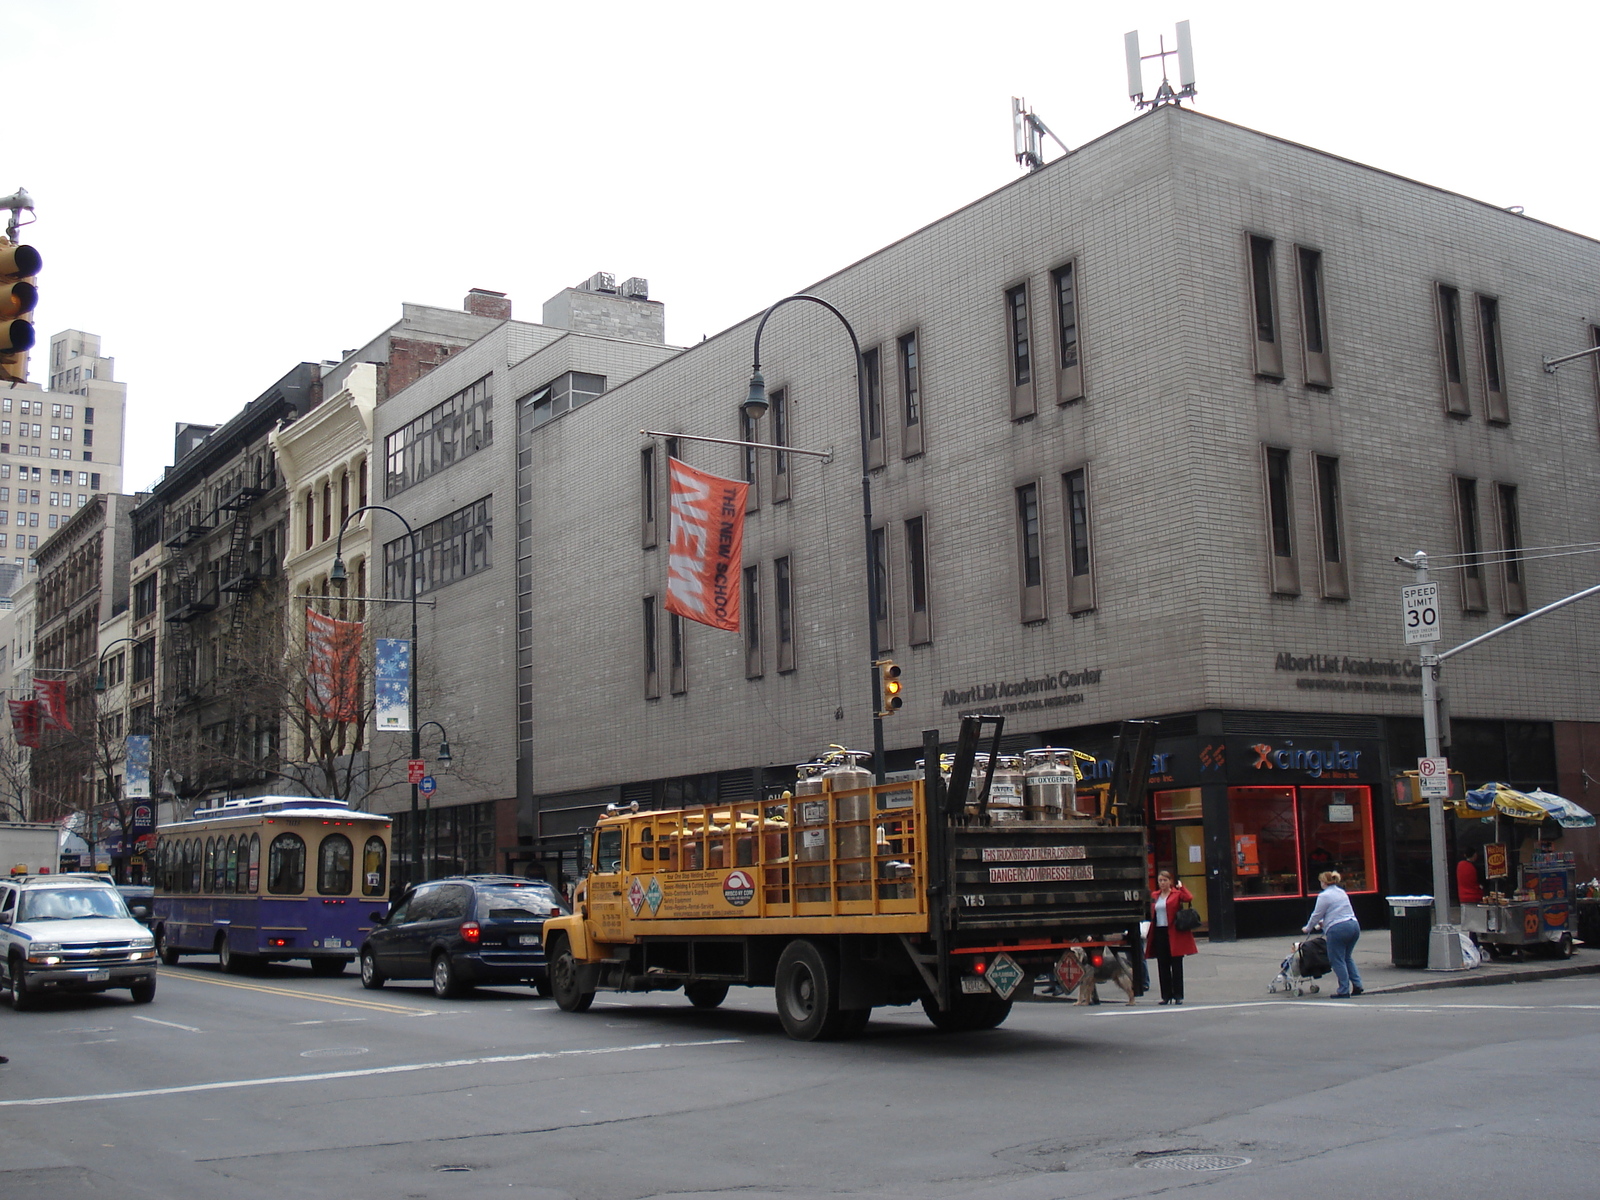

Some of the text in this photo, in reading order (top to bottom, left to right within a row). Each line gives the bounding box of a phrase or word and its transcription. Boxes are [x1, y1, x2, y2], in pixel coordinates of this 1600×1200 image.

[669, 468, 710, 614] NEW
[714, 488, 736, 623] THE NEW SCHOOL
[1404, 587, 1436, 598] SPEED
[1408, 597, 1432, 608] LIMIT
[1407, 608, 1436, 627] 30
[1341, 656, 1402, 677] Academic
[942, 668, 1102, 706] Albert List Academic Center
[1002, 703, 1017, 713] FOR
[1018, 699, 1044, 711] SOCIAL
[1044, 693, 1083, 708] RESEARCH
[1274, 740, 1362, 778] cingular
[984, 849, 996, 860] THIS
[996, 849, 1013, 860] TRUCK
[1014, 848, 1030, 860] STOPS
[1030, 848, 1037, 859] AT
[991, 866, 1093, 882] DANGER COMPRESSED GAS
[963, 895, 985, 907] YES
[1124, 890, 1140, 901] NO
